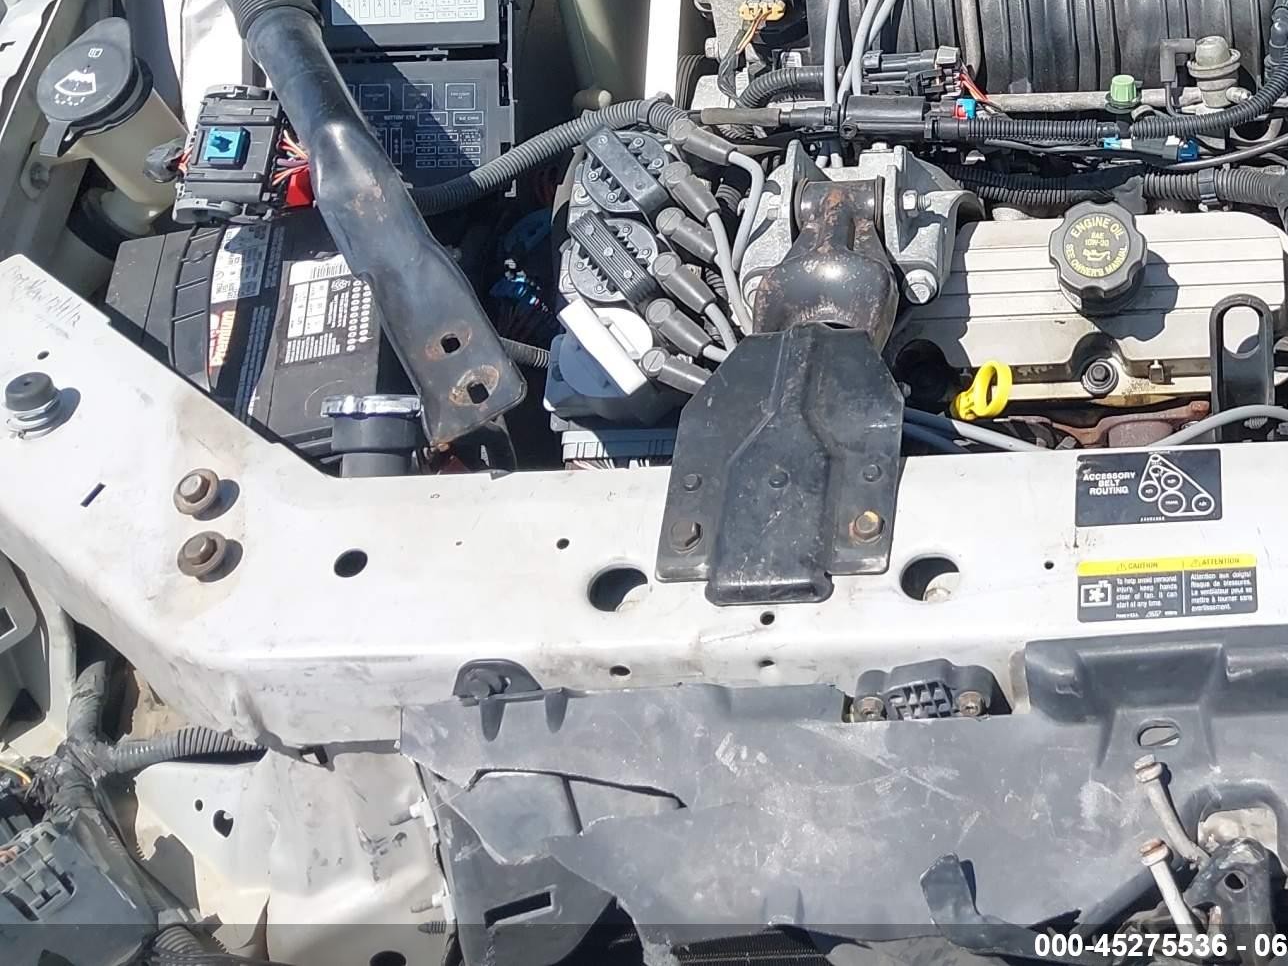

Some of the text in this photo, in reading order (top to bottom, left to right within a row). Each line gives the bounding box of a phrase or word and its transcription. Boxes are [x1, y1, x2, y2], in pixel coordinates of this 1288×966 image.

[1070, 216, 1125, 241] ENGINE OIL
[1065, 243, 1075, 260] SEE
[1105, 245, 1128, 275] MANUAL
[1083, 472, 1136, 482] ACCESSORY
[1098, 479, 1120, 487] BELT
[1089, 486, 1129, 496] ROUTING
[1202, 558, 1239, 566] ATTENTION
[1154, 575, 1177, 584] personal
[1191, 573, 1216, 581] Attention
